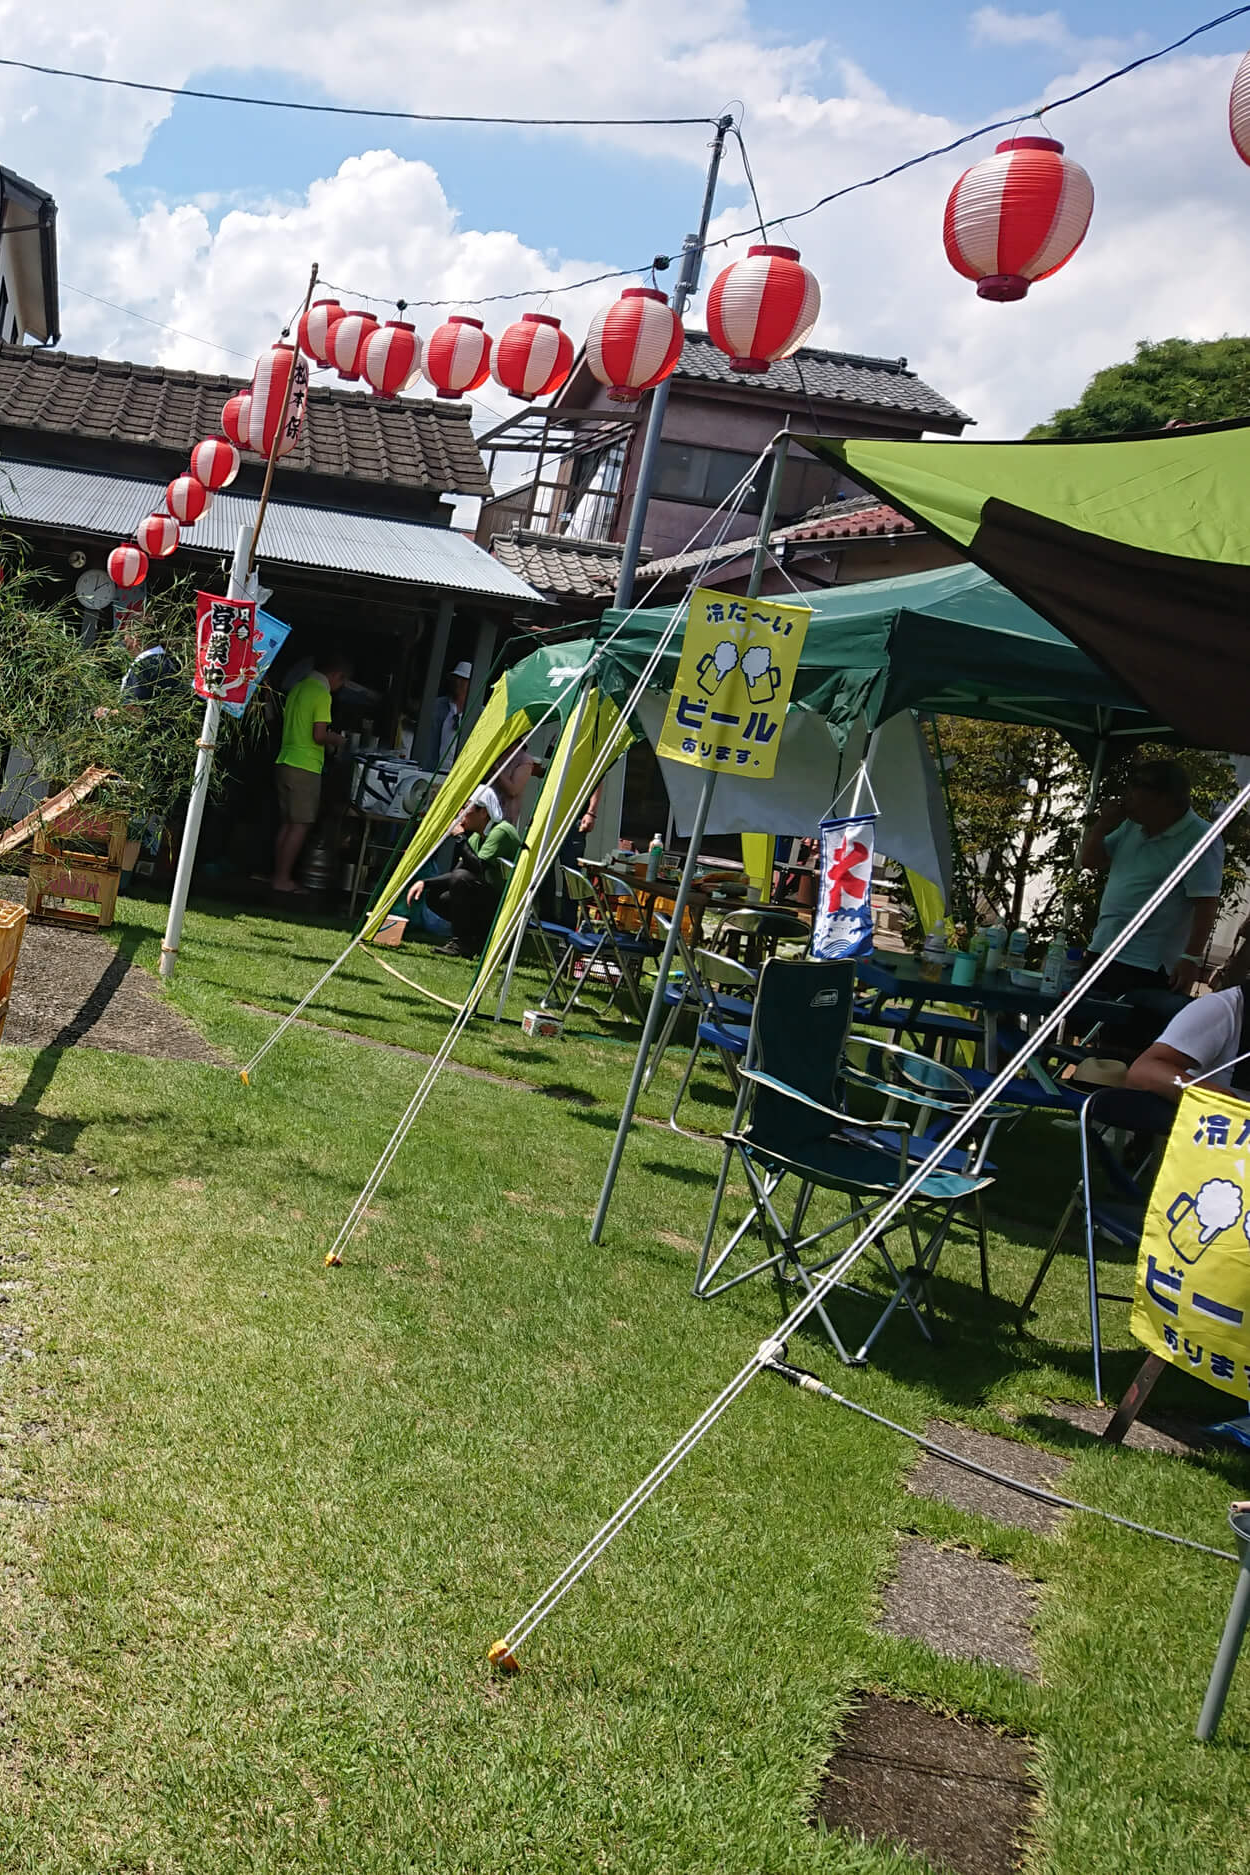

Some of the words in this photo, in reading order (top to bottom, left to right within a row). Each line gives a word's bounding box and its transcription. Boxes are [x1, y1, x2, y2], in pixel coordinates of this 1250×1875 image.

[203, 602, 238, 692] 営業中
[676, 694, 778, 744] ビール
[681, 737, 760, 767] あります。
[1163, 1322, 1250, 1388] ありま
